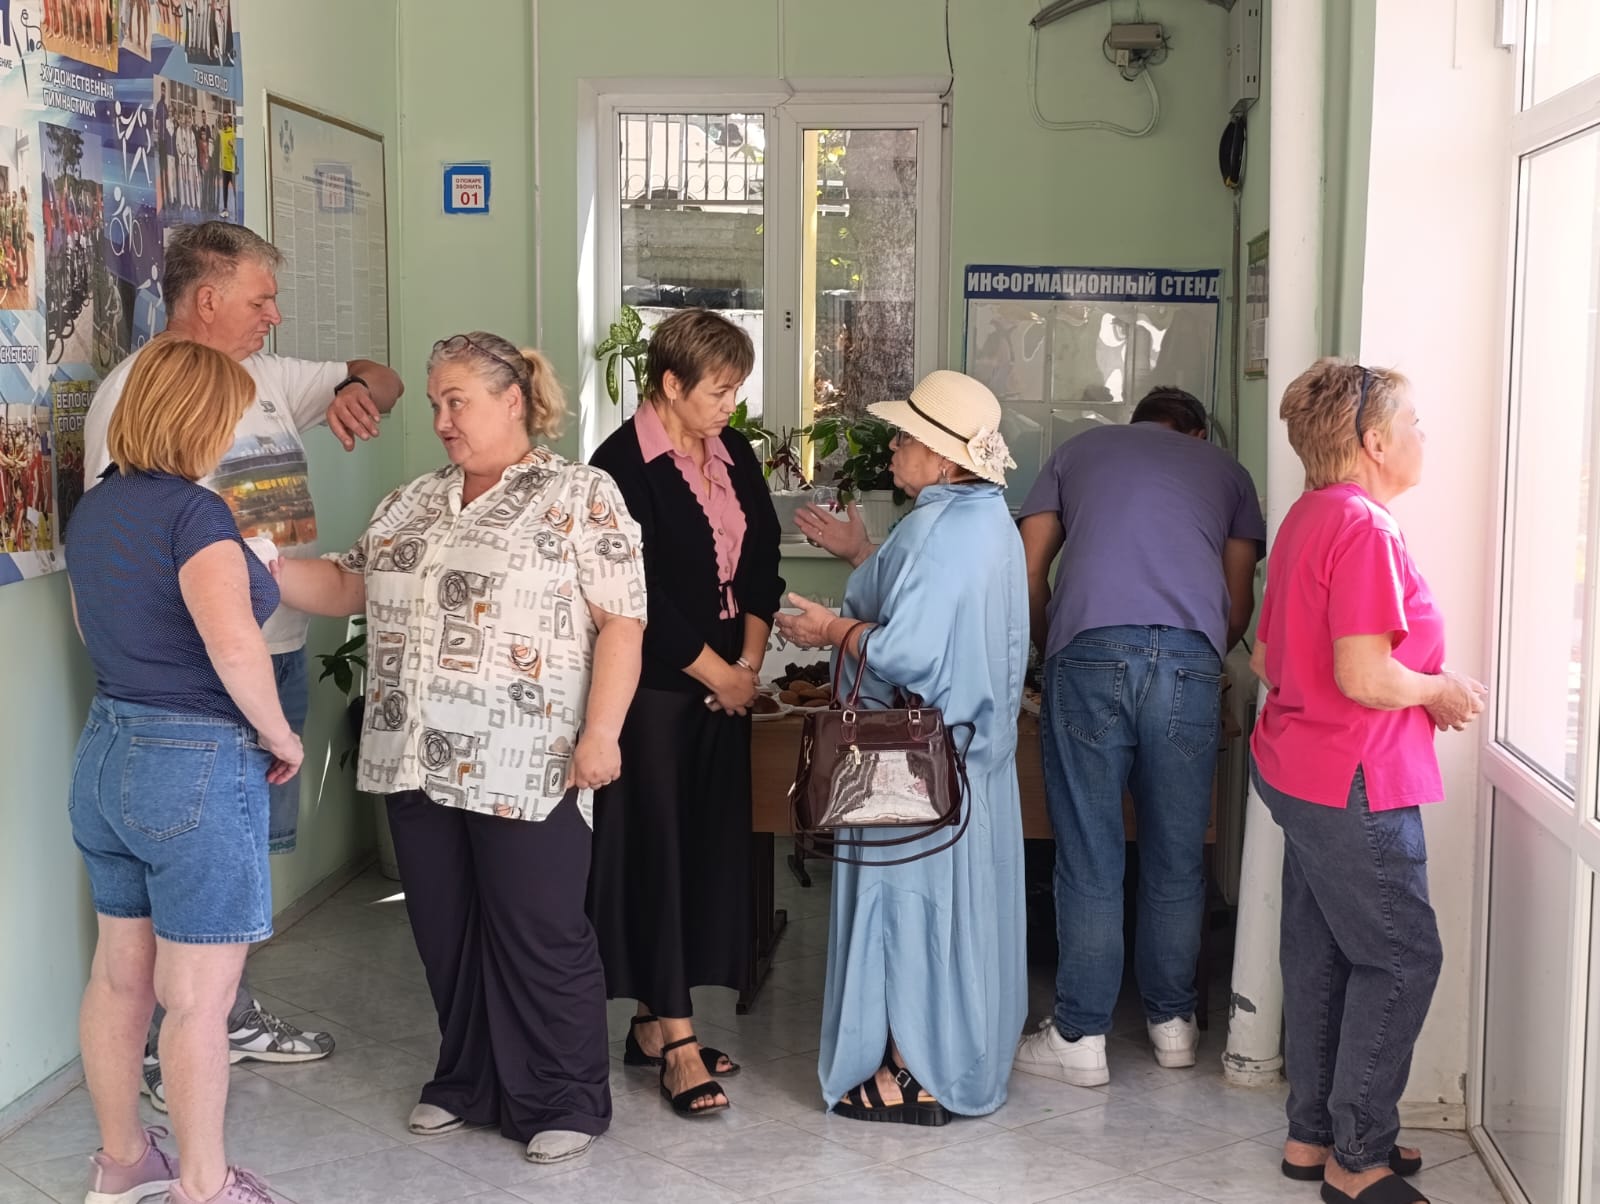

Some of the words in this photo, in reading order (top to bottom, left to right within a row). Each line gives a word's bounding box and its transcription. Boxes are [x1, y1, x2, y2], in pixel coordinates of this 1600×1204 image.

[41, 64, 114, 99] ХУДОЖЕСТВЕННАЯ
[43, 88, 96, 118] ГИМНАСТИКА
[460, 192, 478, 206] 01
[967, 271, 1157, 296] ИНФОРМАЦИОННЫЙ
[1161, 276, 1219, 299] СТЕНД
[56, 392, 96, 408] ВЕЛОСИ
